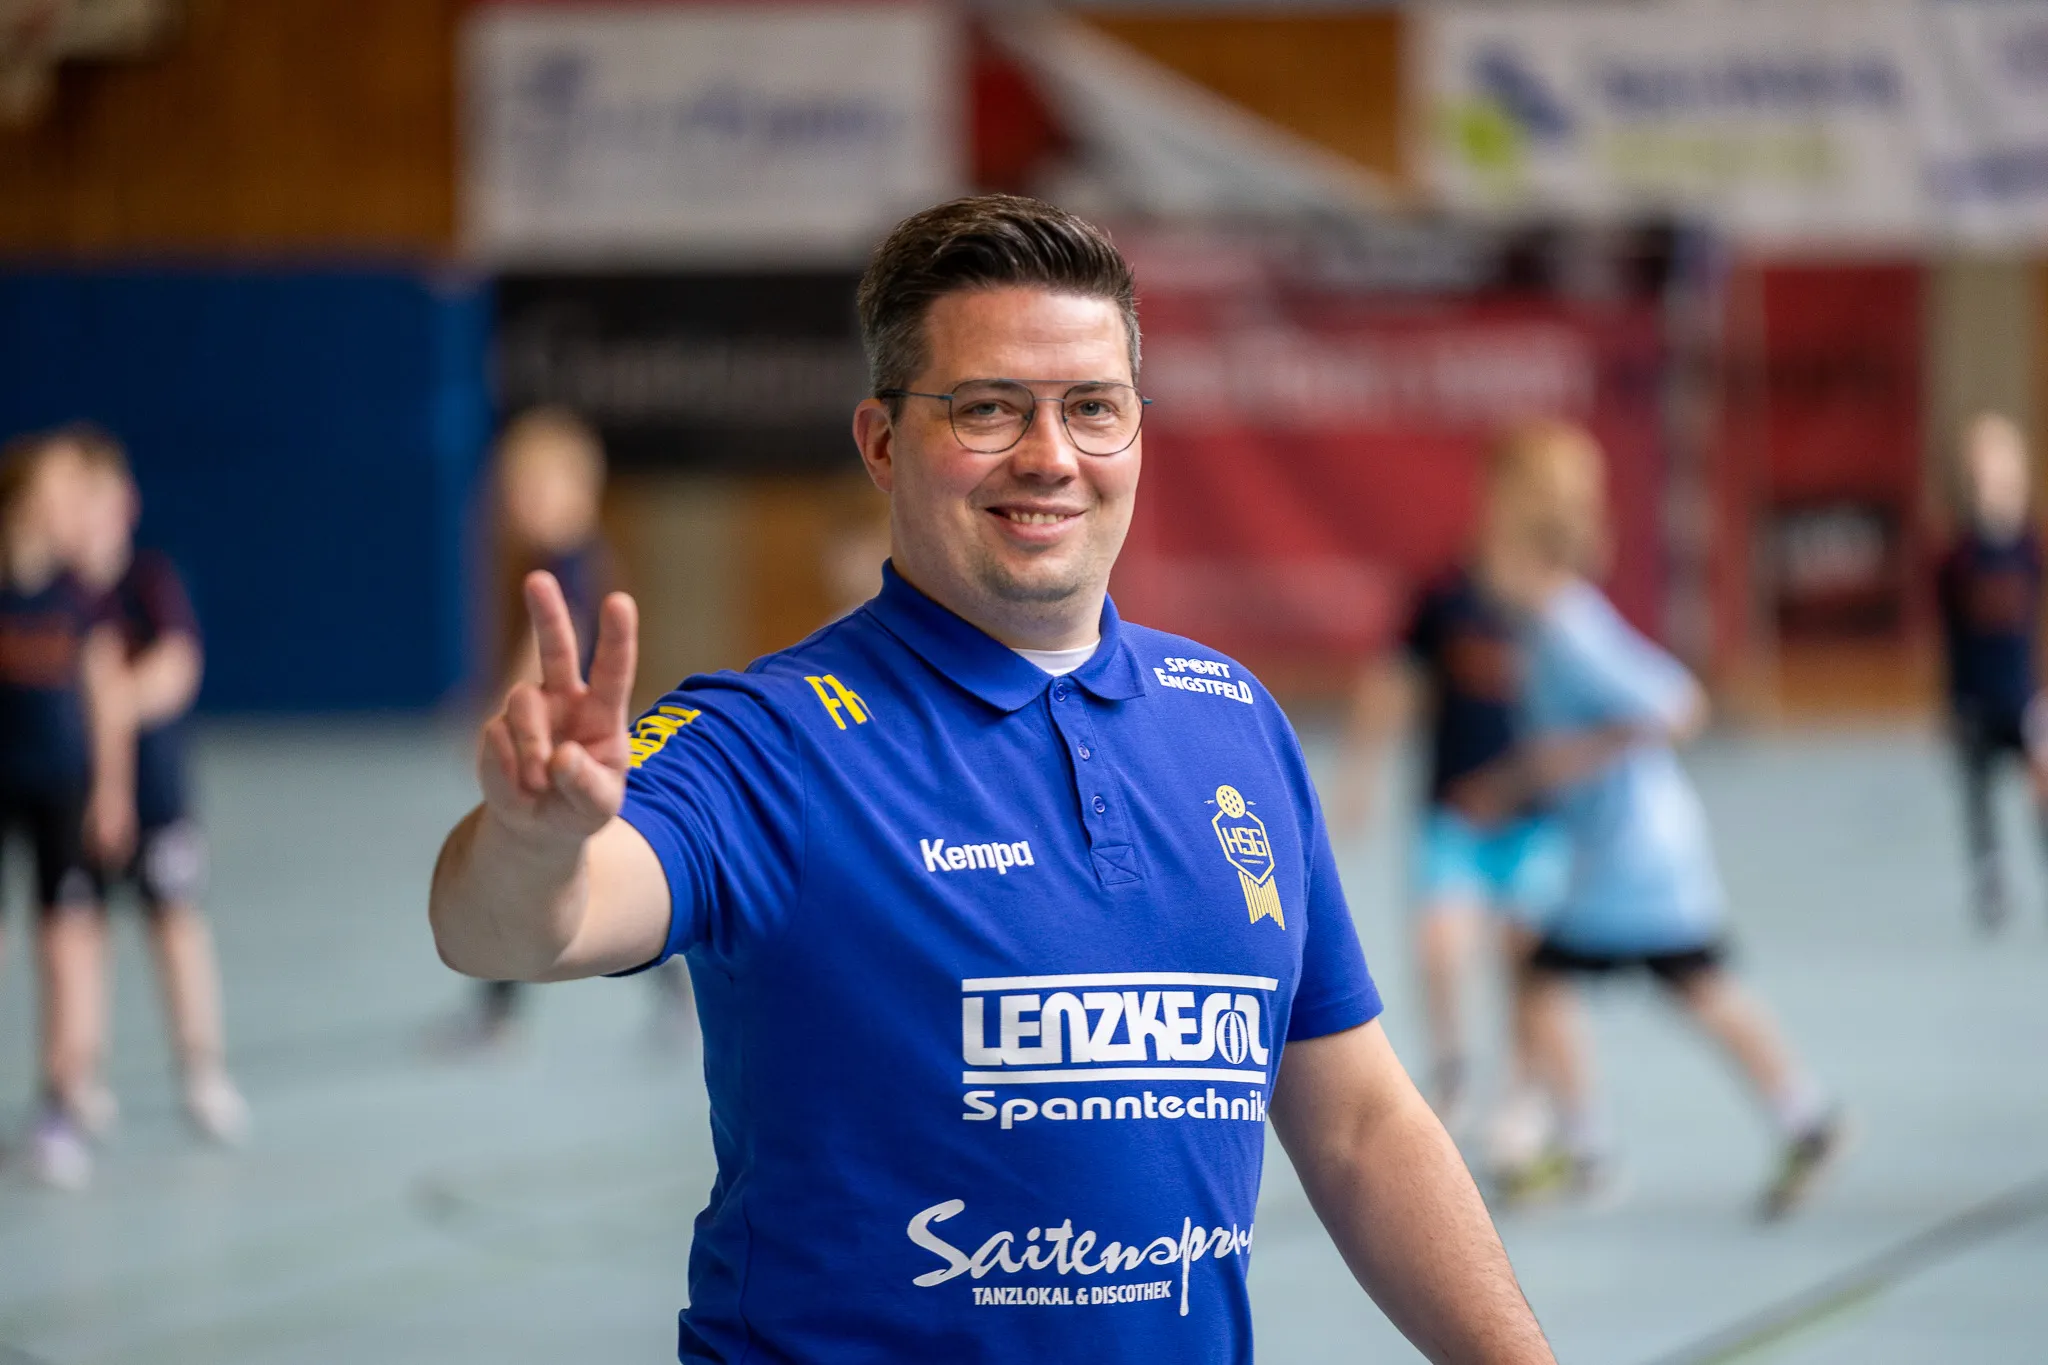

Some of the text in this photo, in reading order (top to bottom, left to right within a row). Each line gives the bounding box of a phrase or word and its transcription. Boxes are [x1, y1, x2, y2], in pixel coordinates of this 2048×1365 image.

[1163, 657, 1231, 678] SPORT
[1153, 667, 1254, 705] ENGSTFELD
[919, 837, 1035, 875] Kempa
[1221, 827, 1267, 856] HSG
[962, 1087, 1266, 1131] Spanntechnik
[972, 1280, 1173, 1306] TANZLOKAL & DISCOTHEK
